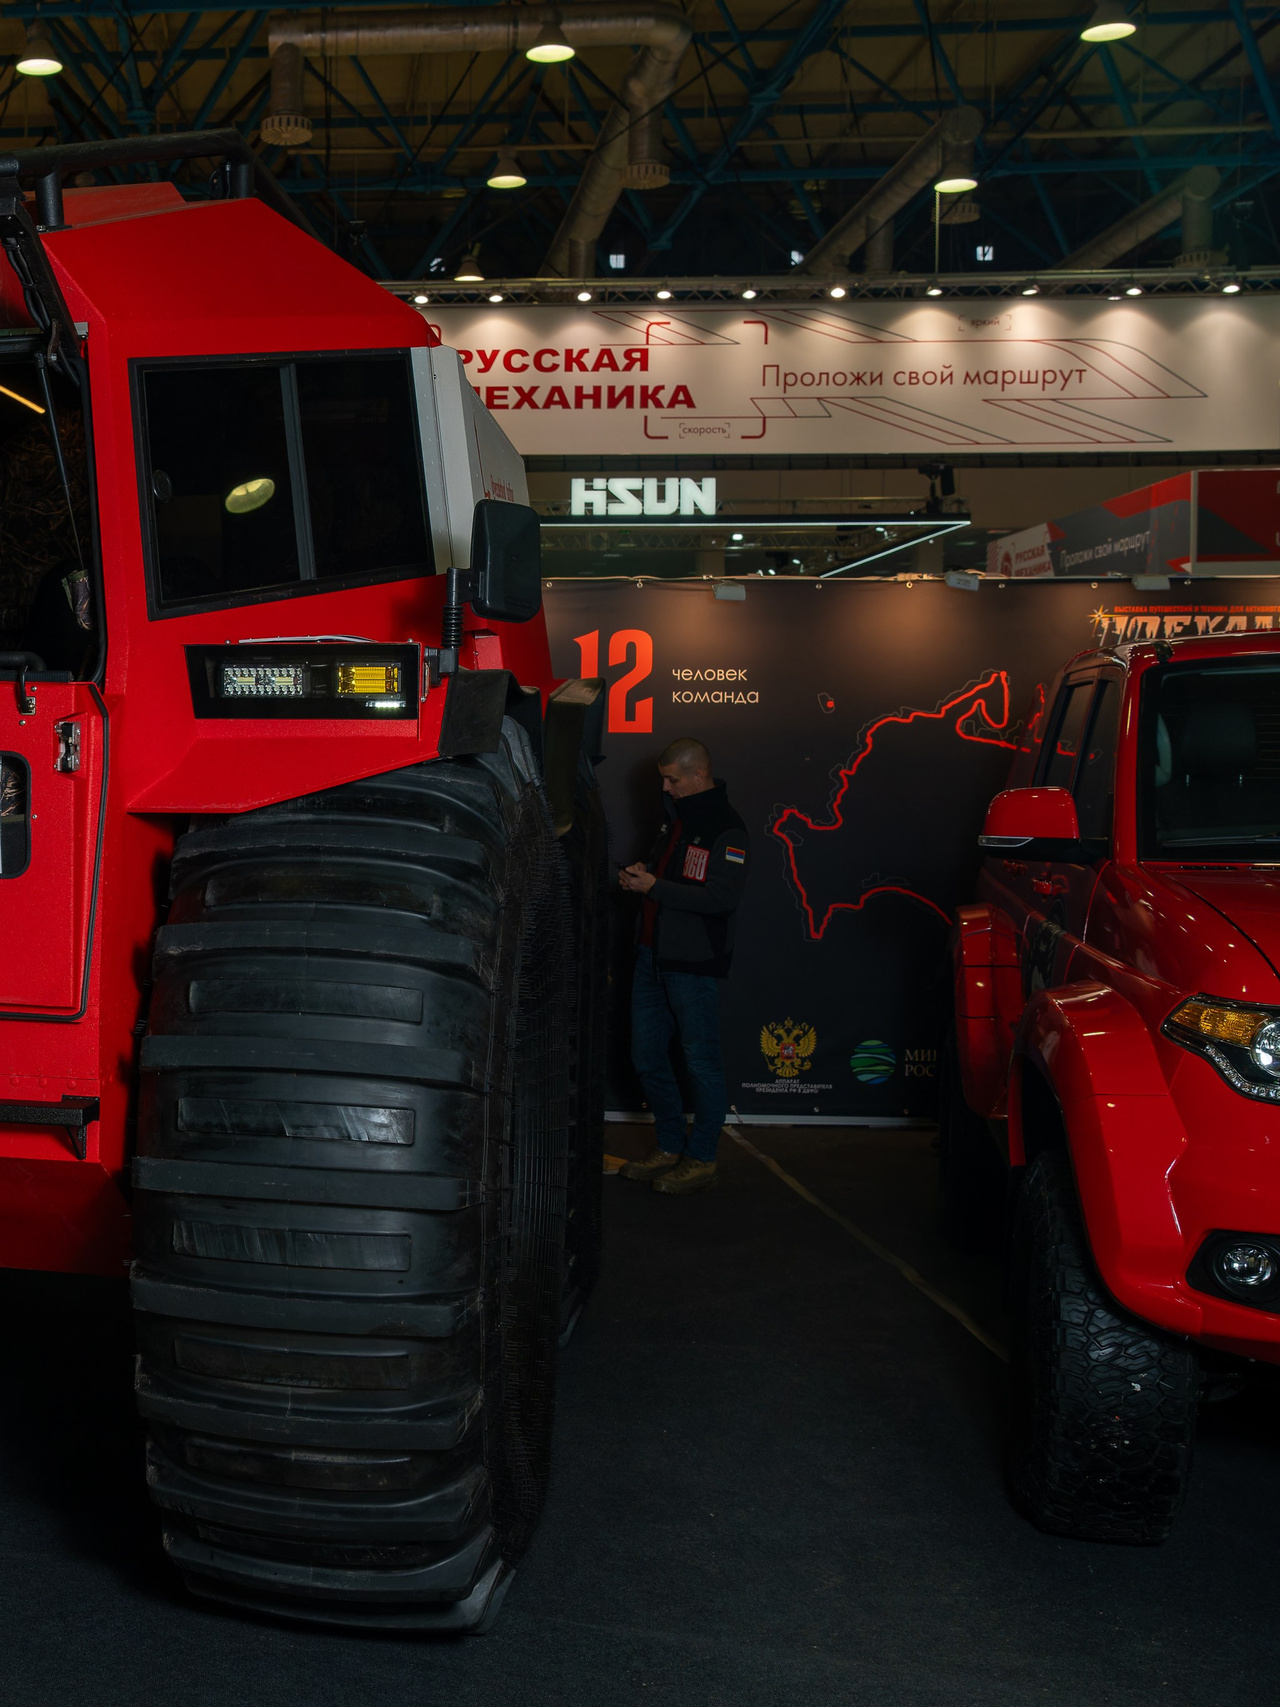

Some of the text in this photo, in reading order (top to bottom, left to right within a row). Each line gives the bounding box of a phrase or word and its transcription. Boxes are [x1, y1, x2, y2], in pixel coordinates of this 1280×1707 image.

[970, 318, 1001, 328] яркий
[762, 364, 1087, 394] Проложи свой маршрут
[682, 425, 727, 436] скорость
[1014, 545, 1046, 564] РУССКАЯ
[1060, 531, 1151, 573] Проложи свой маршрут
[671, 668, 748, 682] человек
[671, 691, 760, 705] команда
